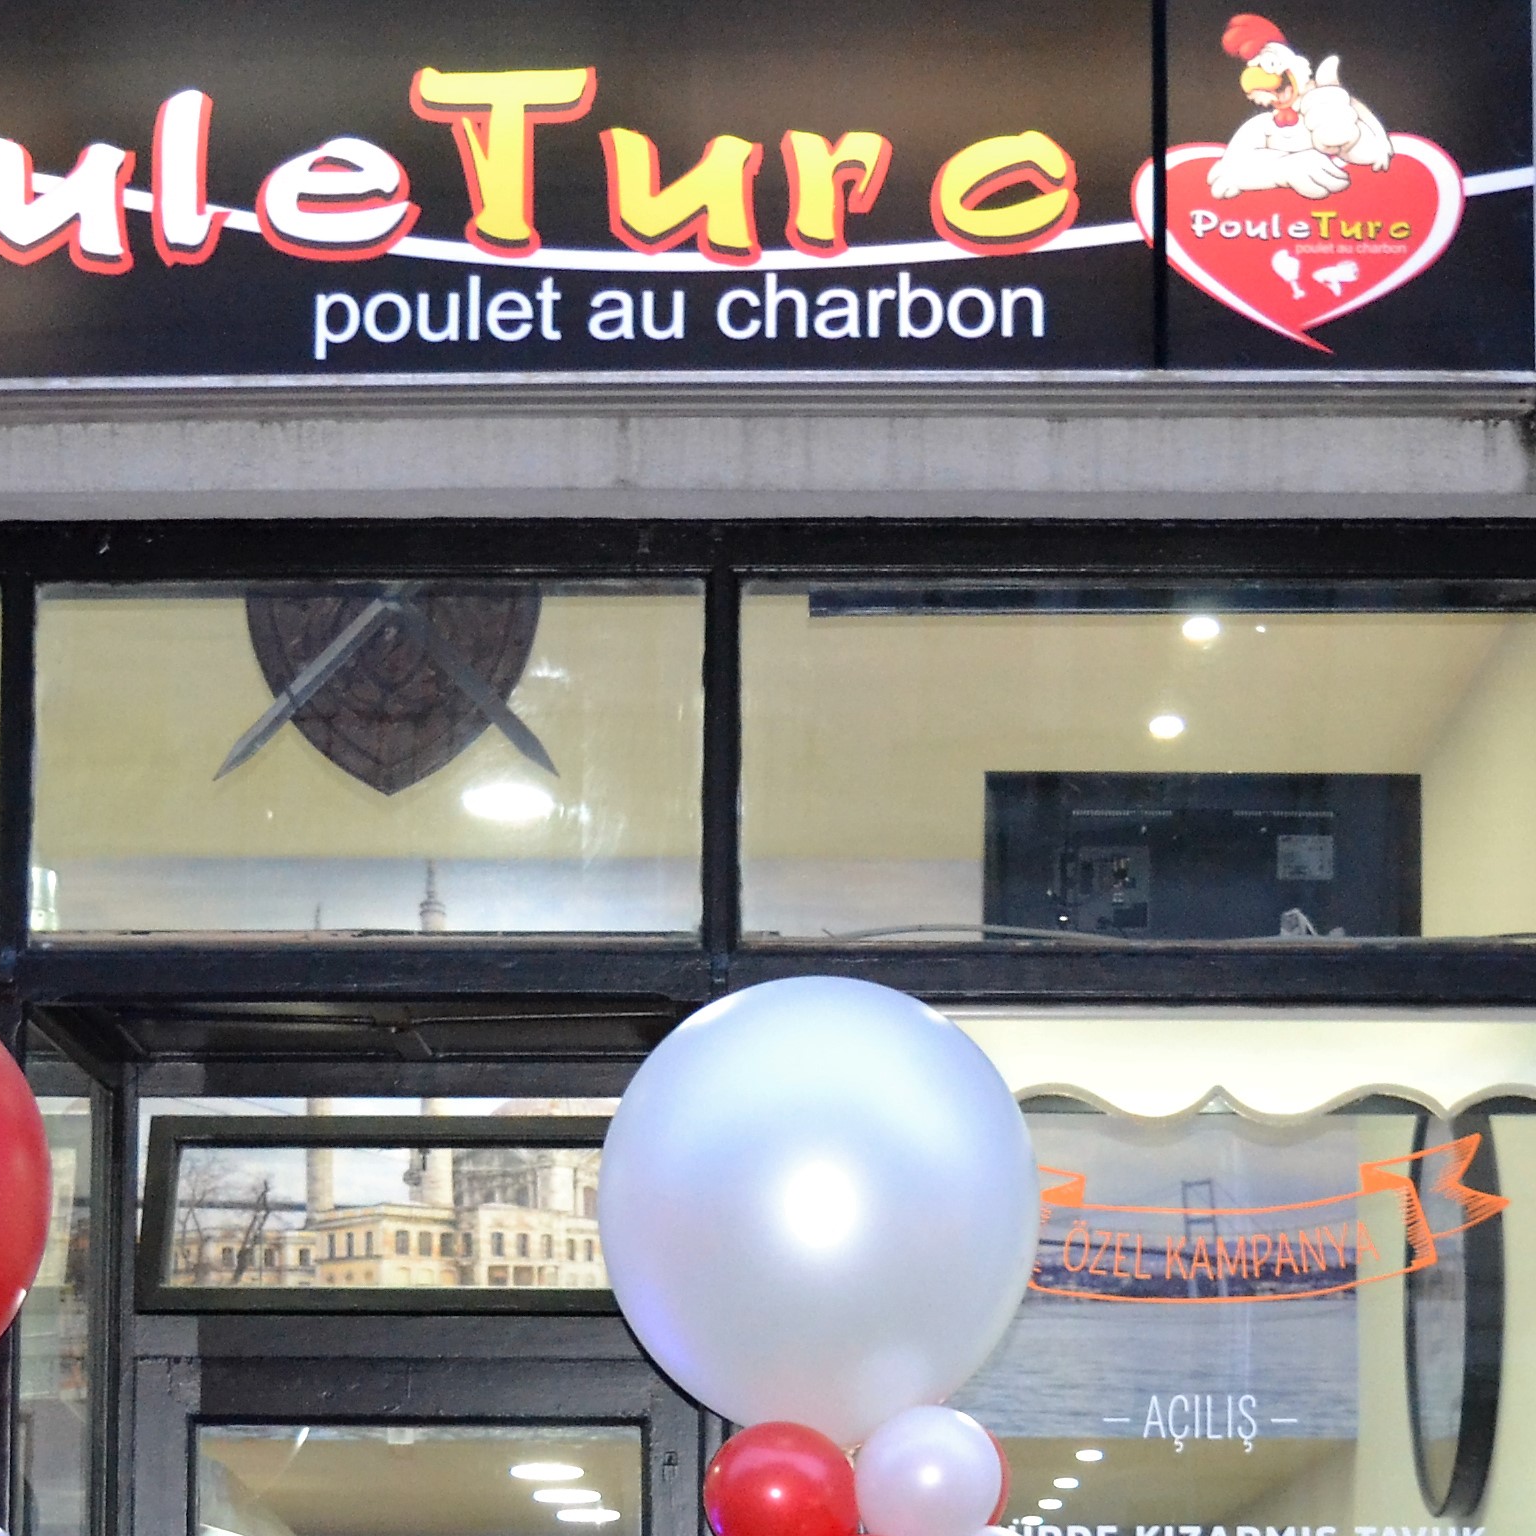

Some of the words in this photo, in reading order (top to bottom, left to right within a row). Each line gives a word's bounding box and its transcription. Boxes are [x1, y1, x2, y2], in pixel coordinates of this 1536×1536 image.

[314, 274, 562, 360] poulet
[588, 289, 685, 340] au
[716, 271, 1045, 340] charbon
[1063, 1220, 1152, 1279] ÖZEL
[1165, 1220, 1381, 1281] KAMPANYA
[1143, 1394, 1258, 1453] AÇILIŞ
